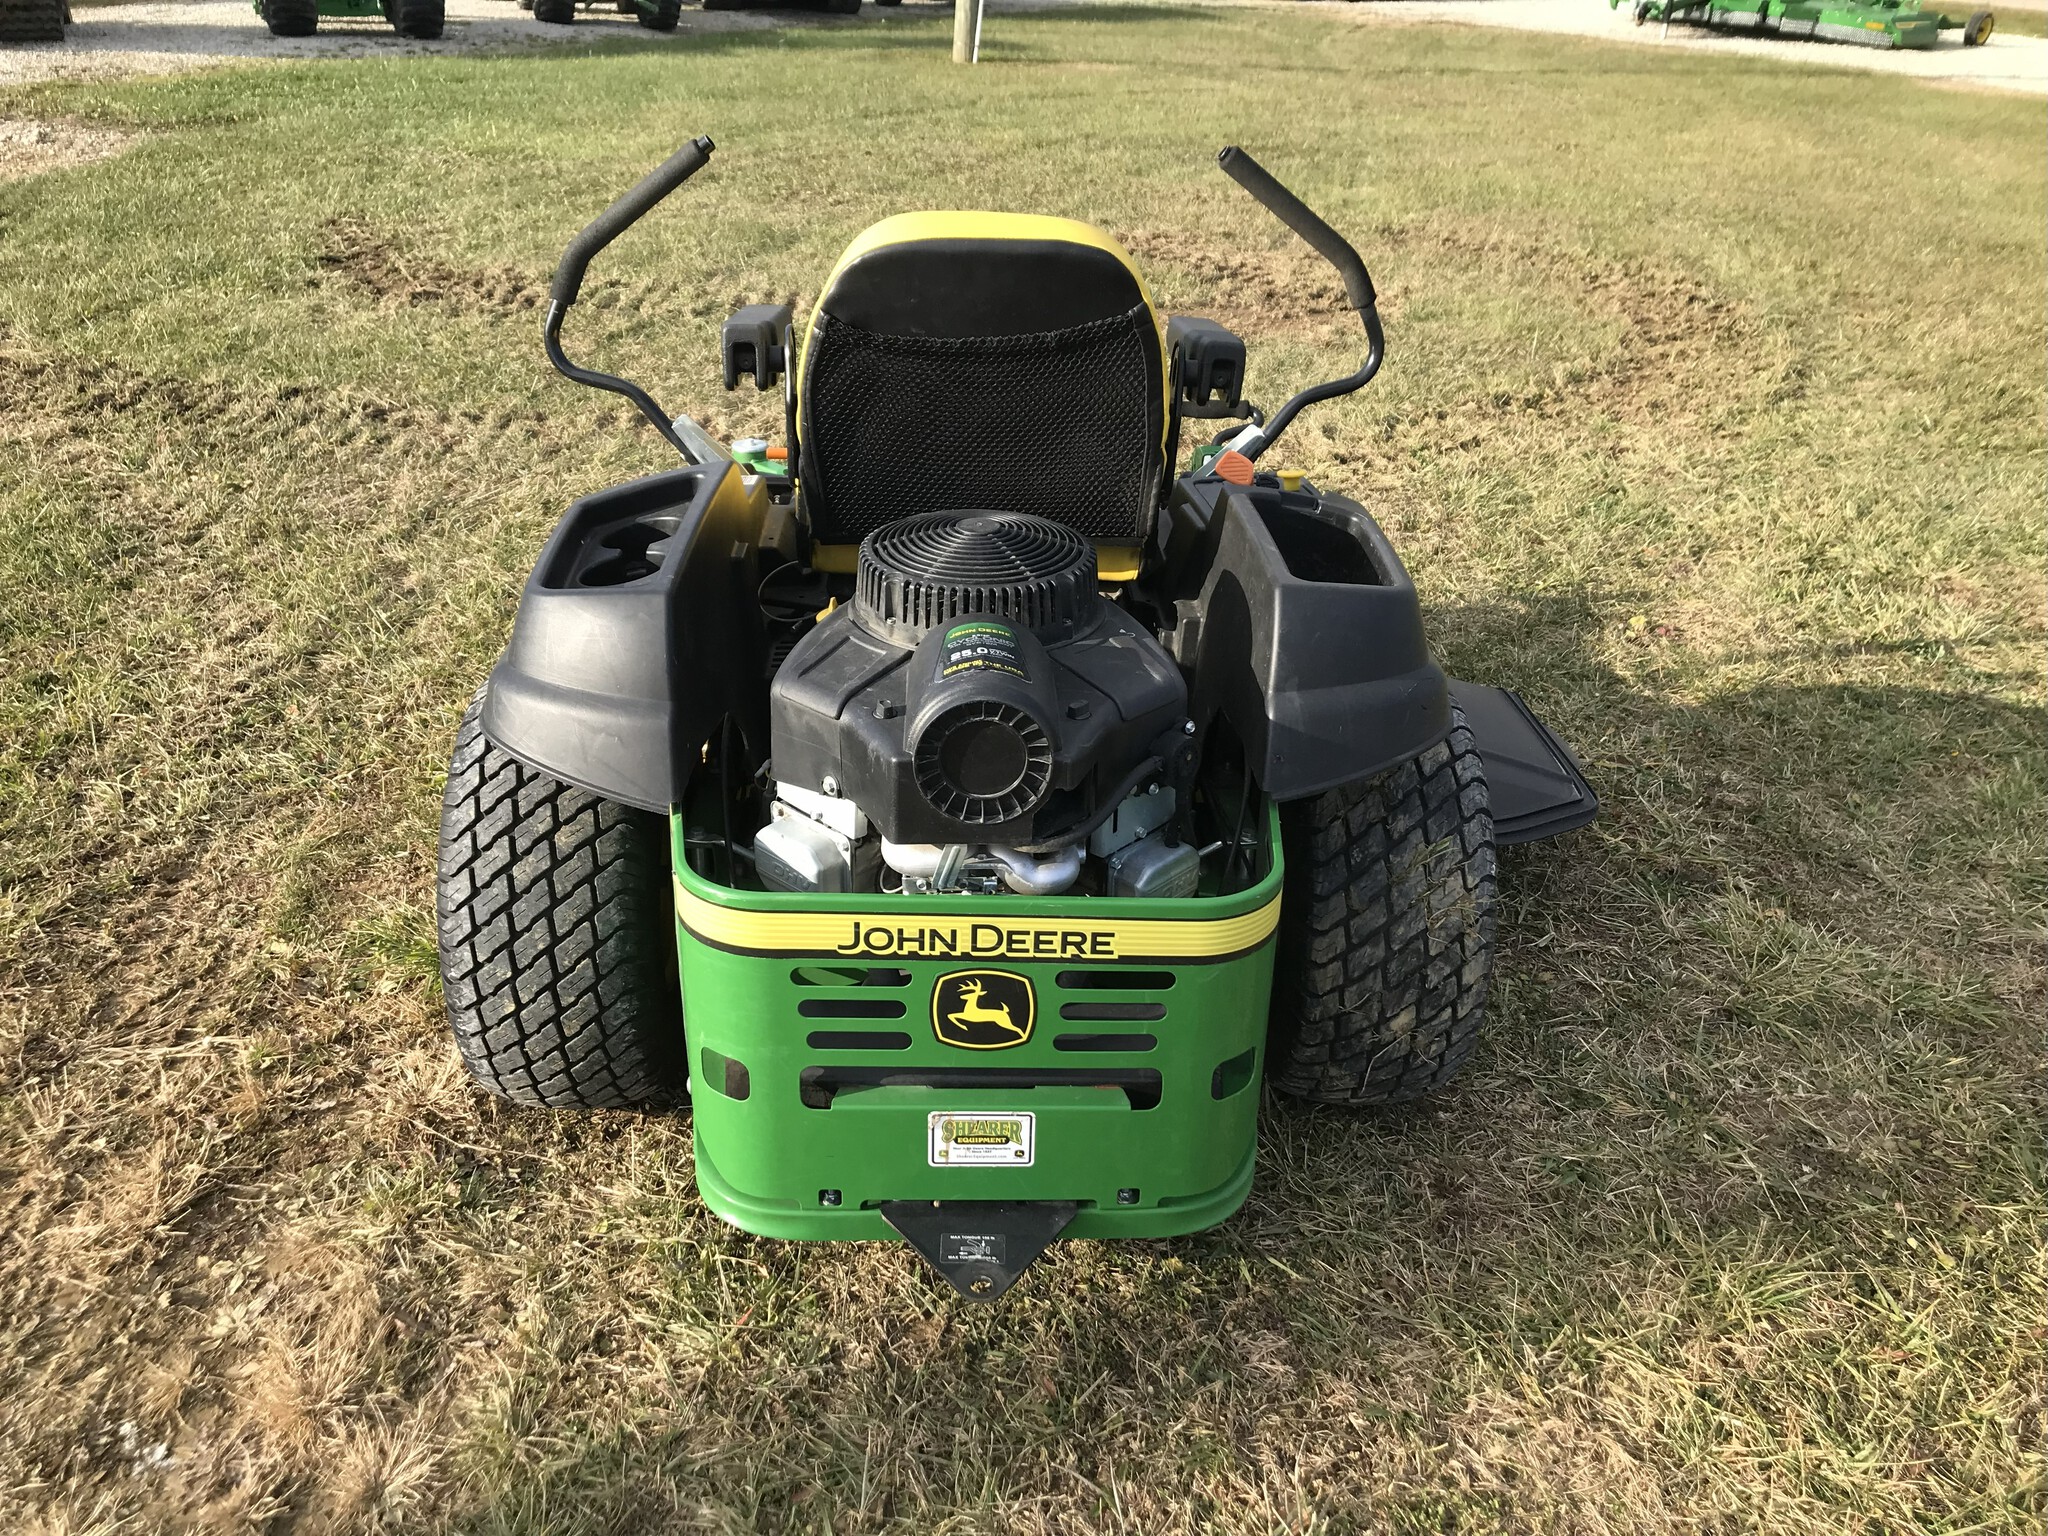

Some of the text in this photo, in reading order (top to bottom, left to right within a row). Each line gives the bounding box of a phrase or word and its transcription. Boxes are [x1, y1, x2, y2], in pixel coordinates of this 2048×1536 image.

[951, 628, 976, 638] JOHN
[978, 628, 1011, 637] DEERE
[950, 646, 988, 661] 25.0
[837, 921, 1116, 955] JOHN DEERE
[942, 1120, 1022, 1145] SHEARER
